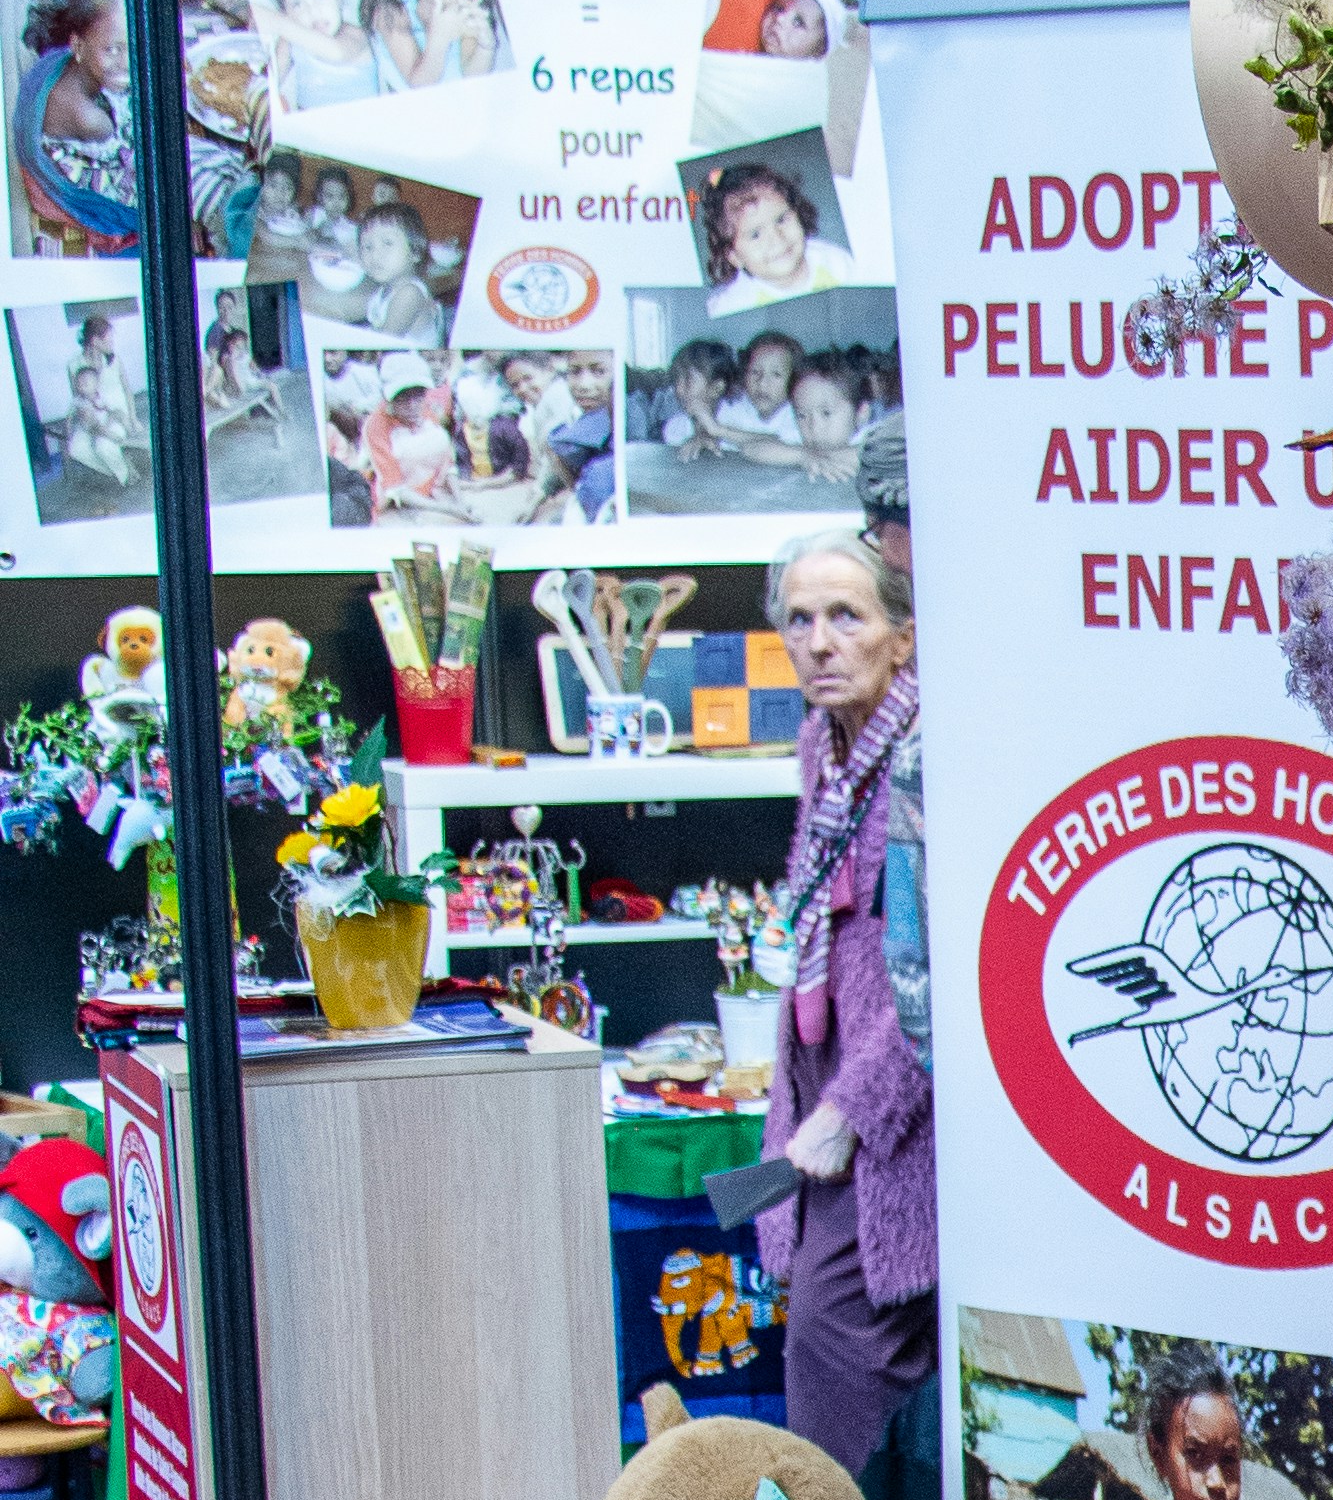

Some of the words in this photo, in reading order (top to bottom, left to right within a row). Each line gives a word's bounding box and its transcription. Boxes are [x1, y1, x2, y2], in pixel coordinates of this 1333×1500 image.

[532, 54, 554, 93] 6
[571, 66, 675, 105] repas
[560, 129, 644, 168] pour
[519, 192, 562, 222] un
[577, 184, 701, 224] enfant
[979, 170, 1254, 253] ADOPT
[1036, 427, 1277, 507] AIDER
[1007, 775, 1153, 916] TERRE
[1159, 761, 1257, 820] DES
